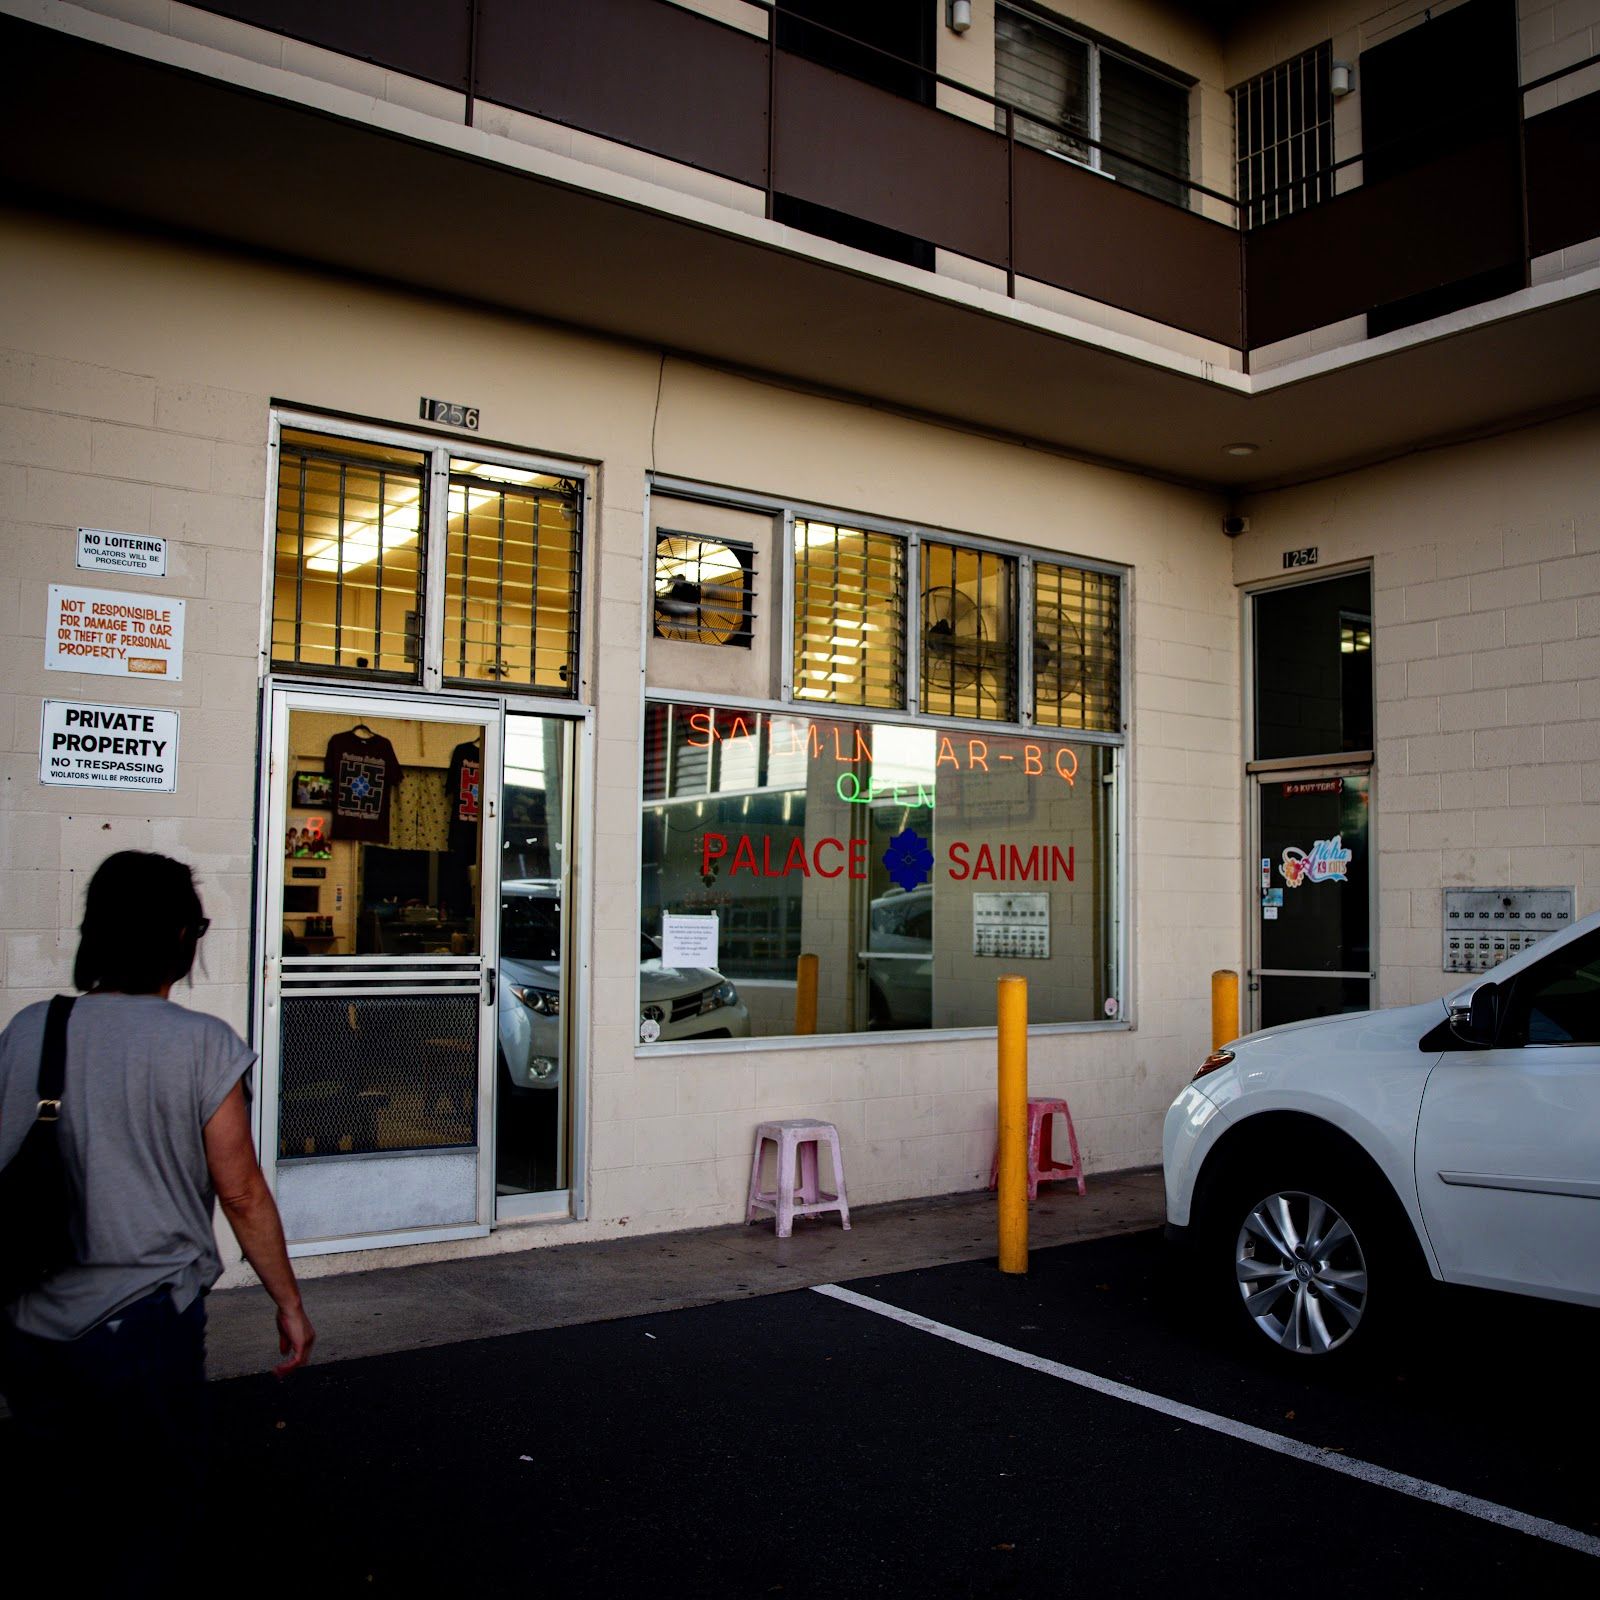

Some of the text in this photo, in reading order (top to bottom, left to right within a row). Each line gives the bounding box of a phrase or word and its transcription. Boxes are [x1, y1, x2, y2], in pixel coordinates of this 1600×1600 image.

[424, 399, 478, 429] 1256
[84, 534, 162, 552] NO LOITERING
[84, 547, 126, 558] VIOLATORS
[129, 553, 146, 561] WILL
[95, 557, 147, 568] PROSECUTED
[1285, 548, 1317, 568] 1254
[60, 599, 171, 622] NOT RESPONSIBLE
[60, 614, 172, 636] FOR DAMAGE TO CAR
[58, 628, 171, 650] OR THEFT OF PERSONAL
[58, 642, 126, 660] PROPERTY.
[65, 709, 154, 733] PRIVATE
[52, 733, 167, 757] PROPERTY
[51, 757, 164, 773] NO TRESPASSING
[936, 737, 1078, 786] AR-BQ
[50, 771, 89, 780] VIOLATORS
[91, 773, 108, 781] WILL
[120, 775, 163, 784] PROSECUTED
[836, 772, 936, 808] OPEN
[702, 832, 1075, 882] PALACE SAIMIN
[1317, 860, 1346, 874] K9 KUTS
